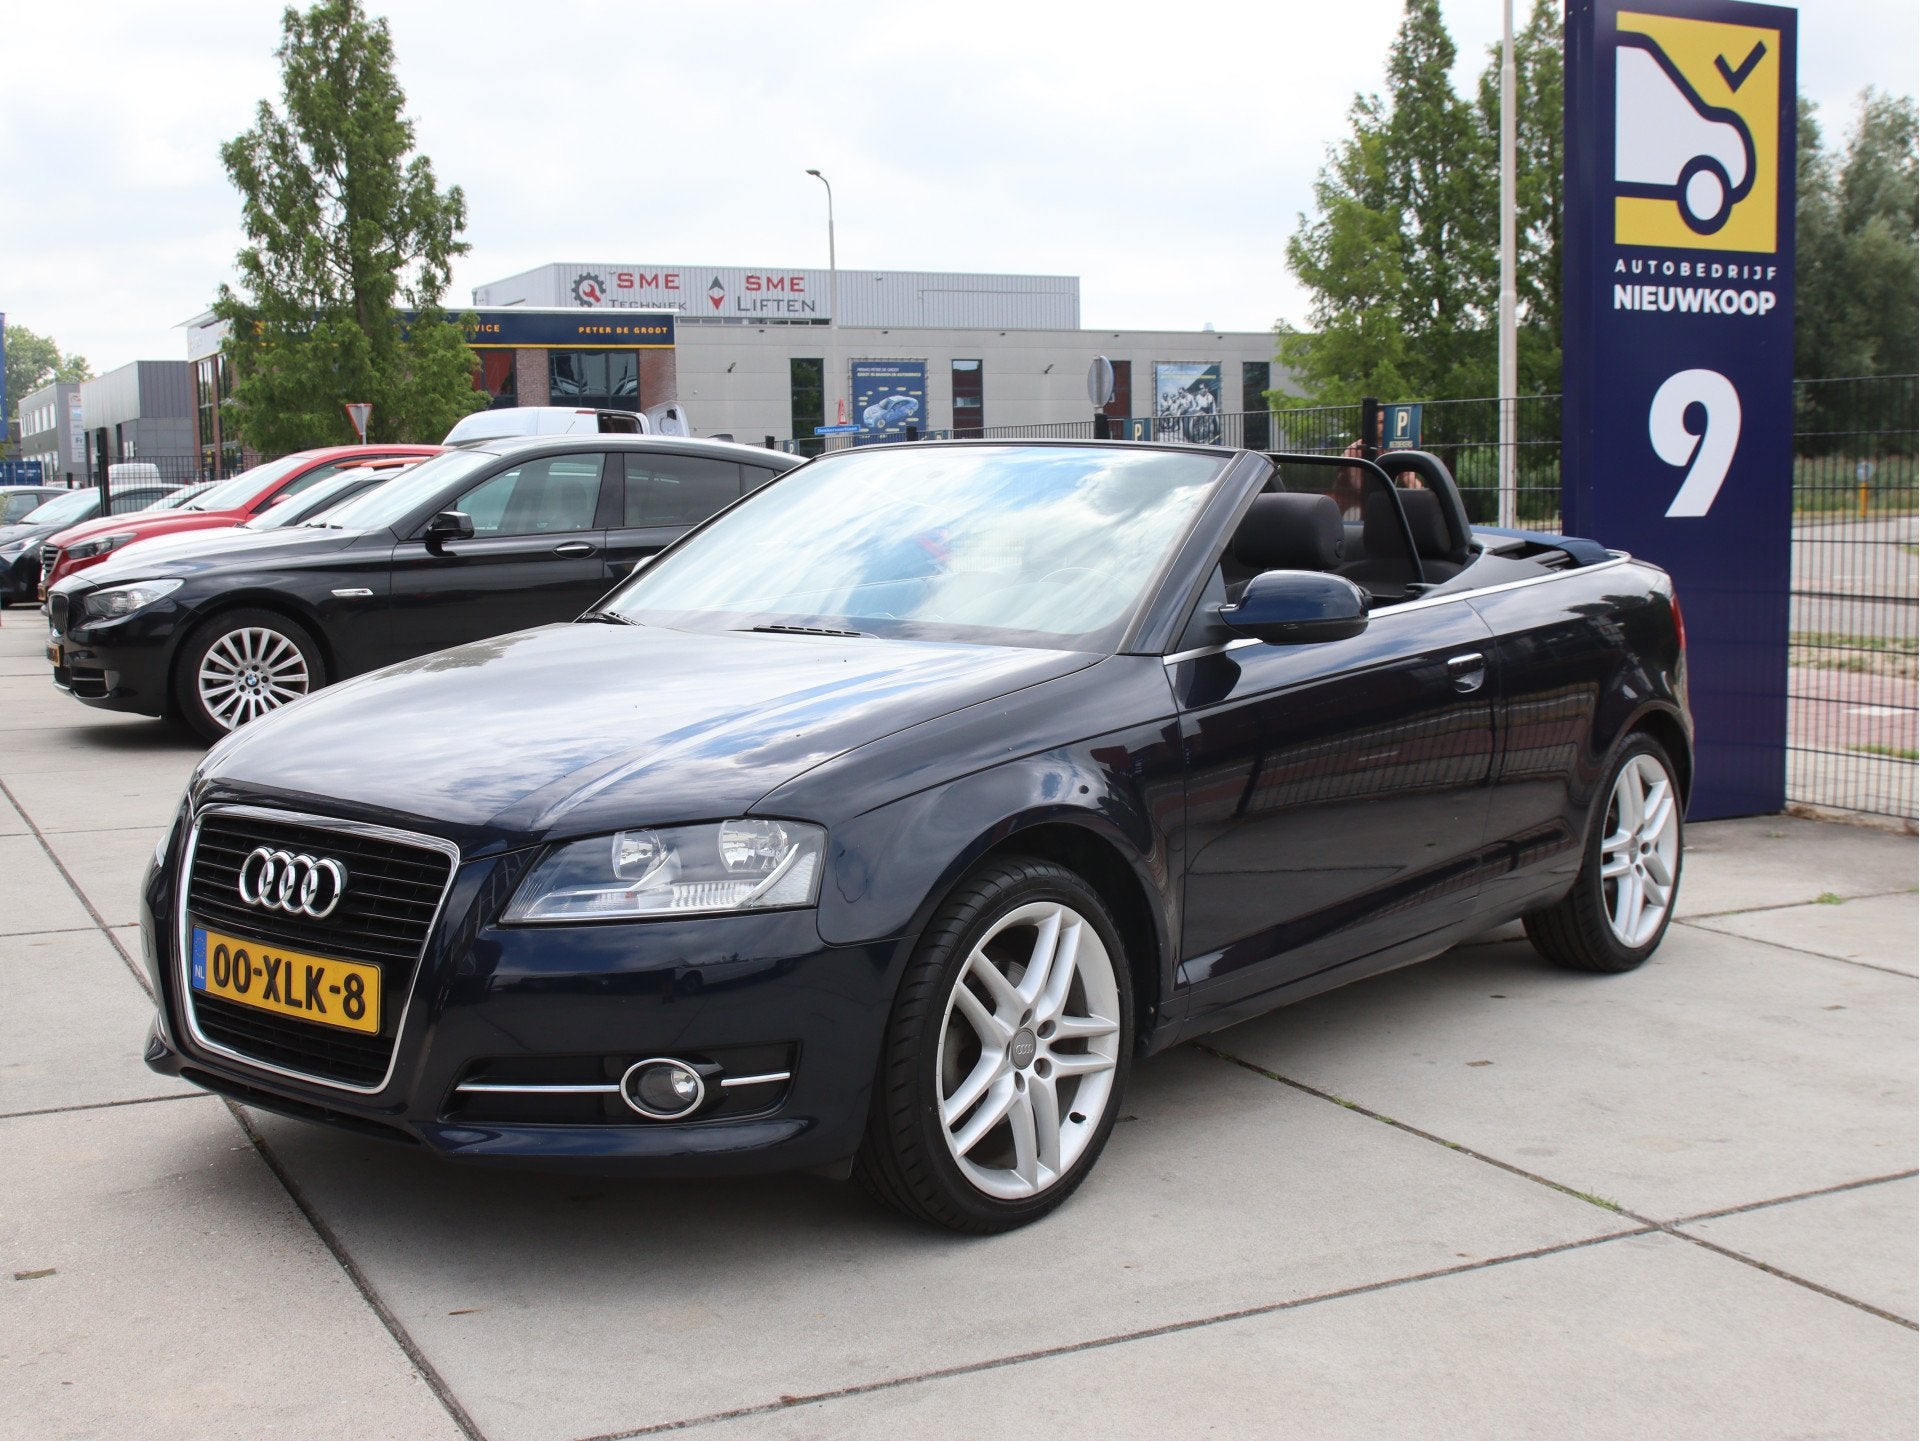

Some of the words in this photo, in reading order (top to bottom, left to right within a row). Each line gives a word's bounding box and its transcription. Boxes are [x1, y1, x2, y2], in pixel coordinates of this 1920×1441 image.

[1615, 258, 1778, 281] AUTOBEDRIJF
[616, 272, 680, 290] SME
[745, 275, 805, 292] SME
[737, 296, 815, 312] LIFTEN
[1614, 284, 1777, 315] NIEUWKOOP
[578, 326, 612, 334] PETER
[1134, 423, 1142, 441] P
[1397, 411, 1408, 437] P
[1648, 368, 1742, 518] 9
[194, 964, 205, 979] NL
[213, 943, 366, 1021] 00-XLK-8
